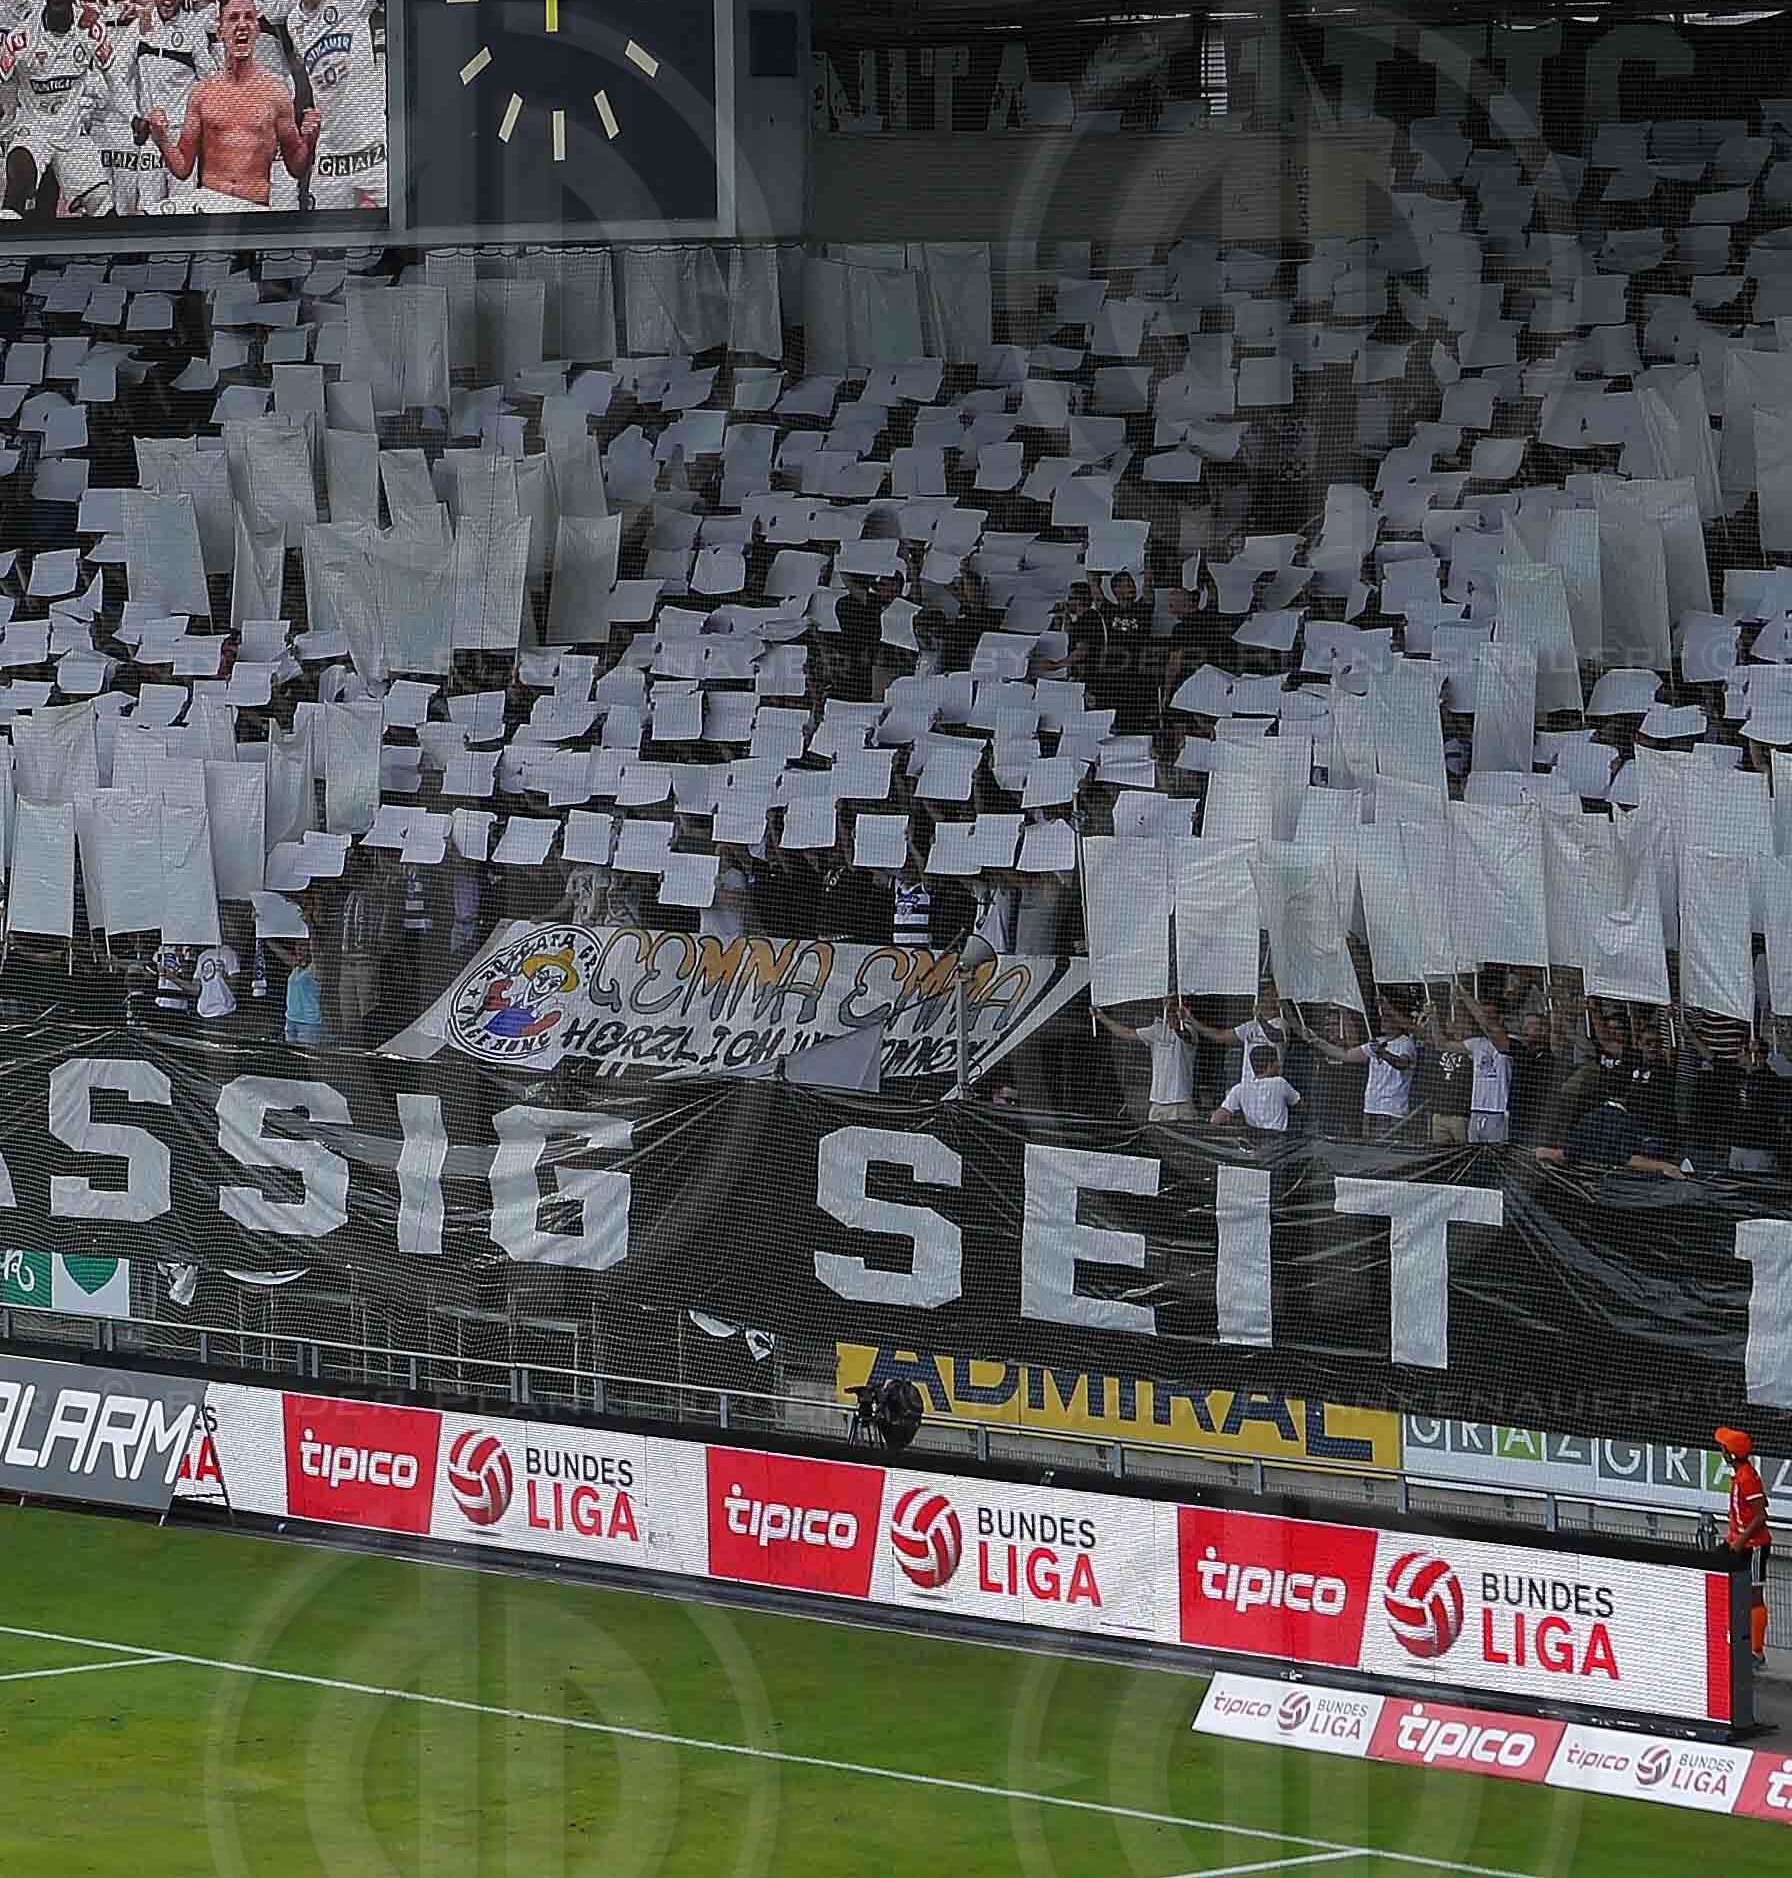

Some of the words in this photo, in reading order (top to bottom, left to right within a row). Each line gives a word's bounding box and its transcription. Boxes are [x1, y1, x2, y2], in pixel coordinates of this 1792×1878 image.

[814, 1125, 1505, 1368] SEIT
[300, 1427, 419, 1489] tipico
[526, 1447, 634, 1487] BUNDES
[527, 1479, 639, 1543] LIGA
[723, 1482, 859, 1549] tipico
[978, 1506, 1097, 1549] BUNDES
[978, 1540, 1103, 1609] LIGA
[1197, 1545, 1348, 1616] tipico
[1481, 1571, 1615, 1619] BUNDES
[1482, 1608, 1621, 1681] LIGA
[1213, 1690, 1273, 1718] tipico
[1309, 1713, 1361, 1741] LIGA
[1317, 1697, 1369, 1719] BUNDES
[1396, 1702, 1536, 1767] tipico
[1566, 1742, 1630, 1772] tipico
[1671, 1769, 1729, 1798] LIGA
[1678, 1752, 1736, 1774] BUNDES
